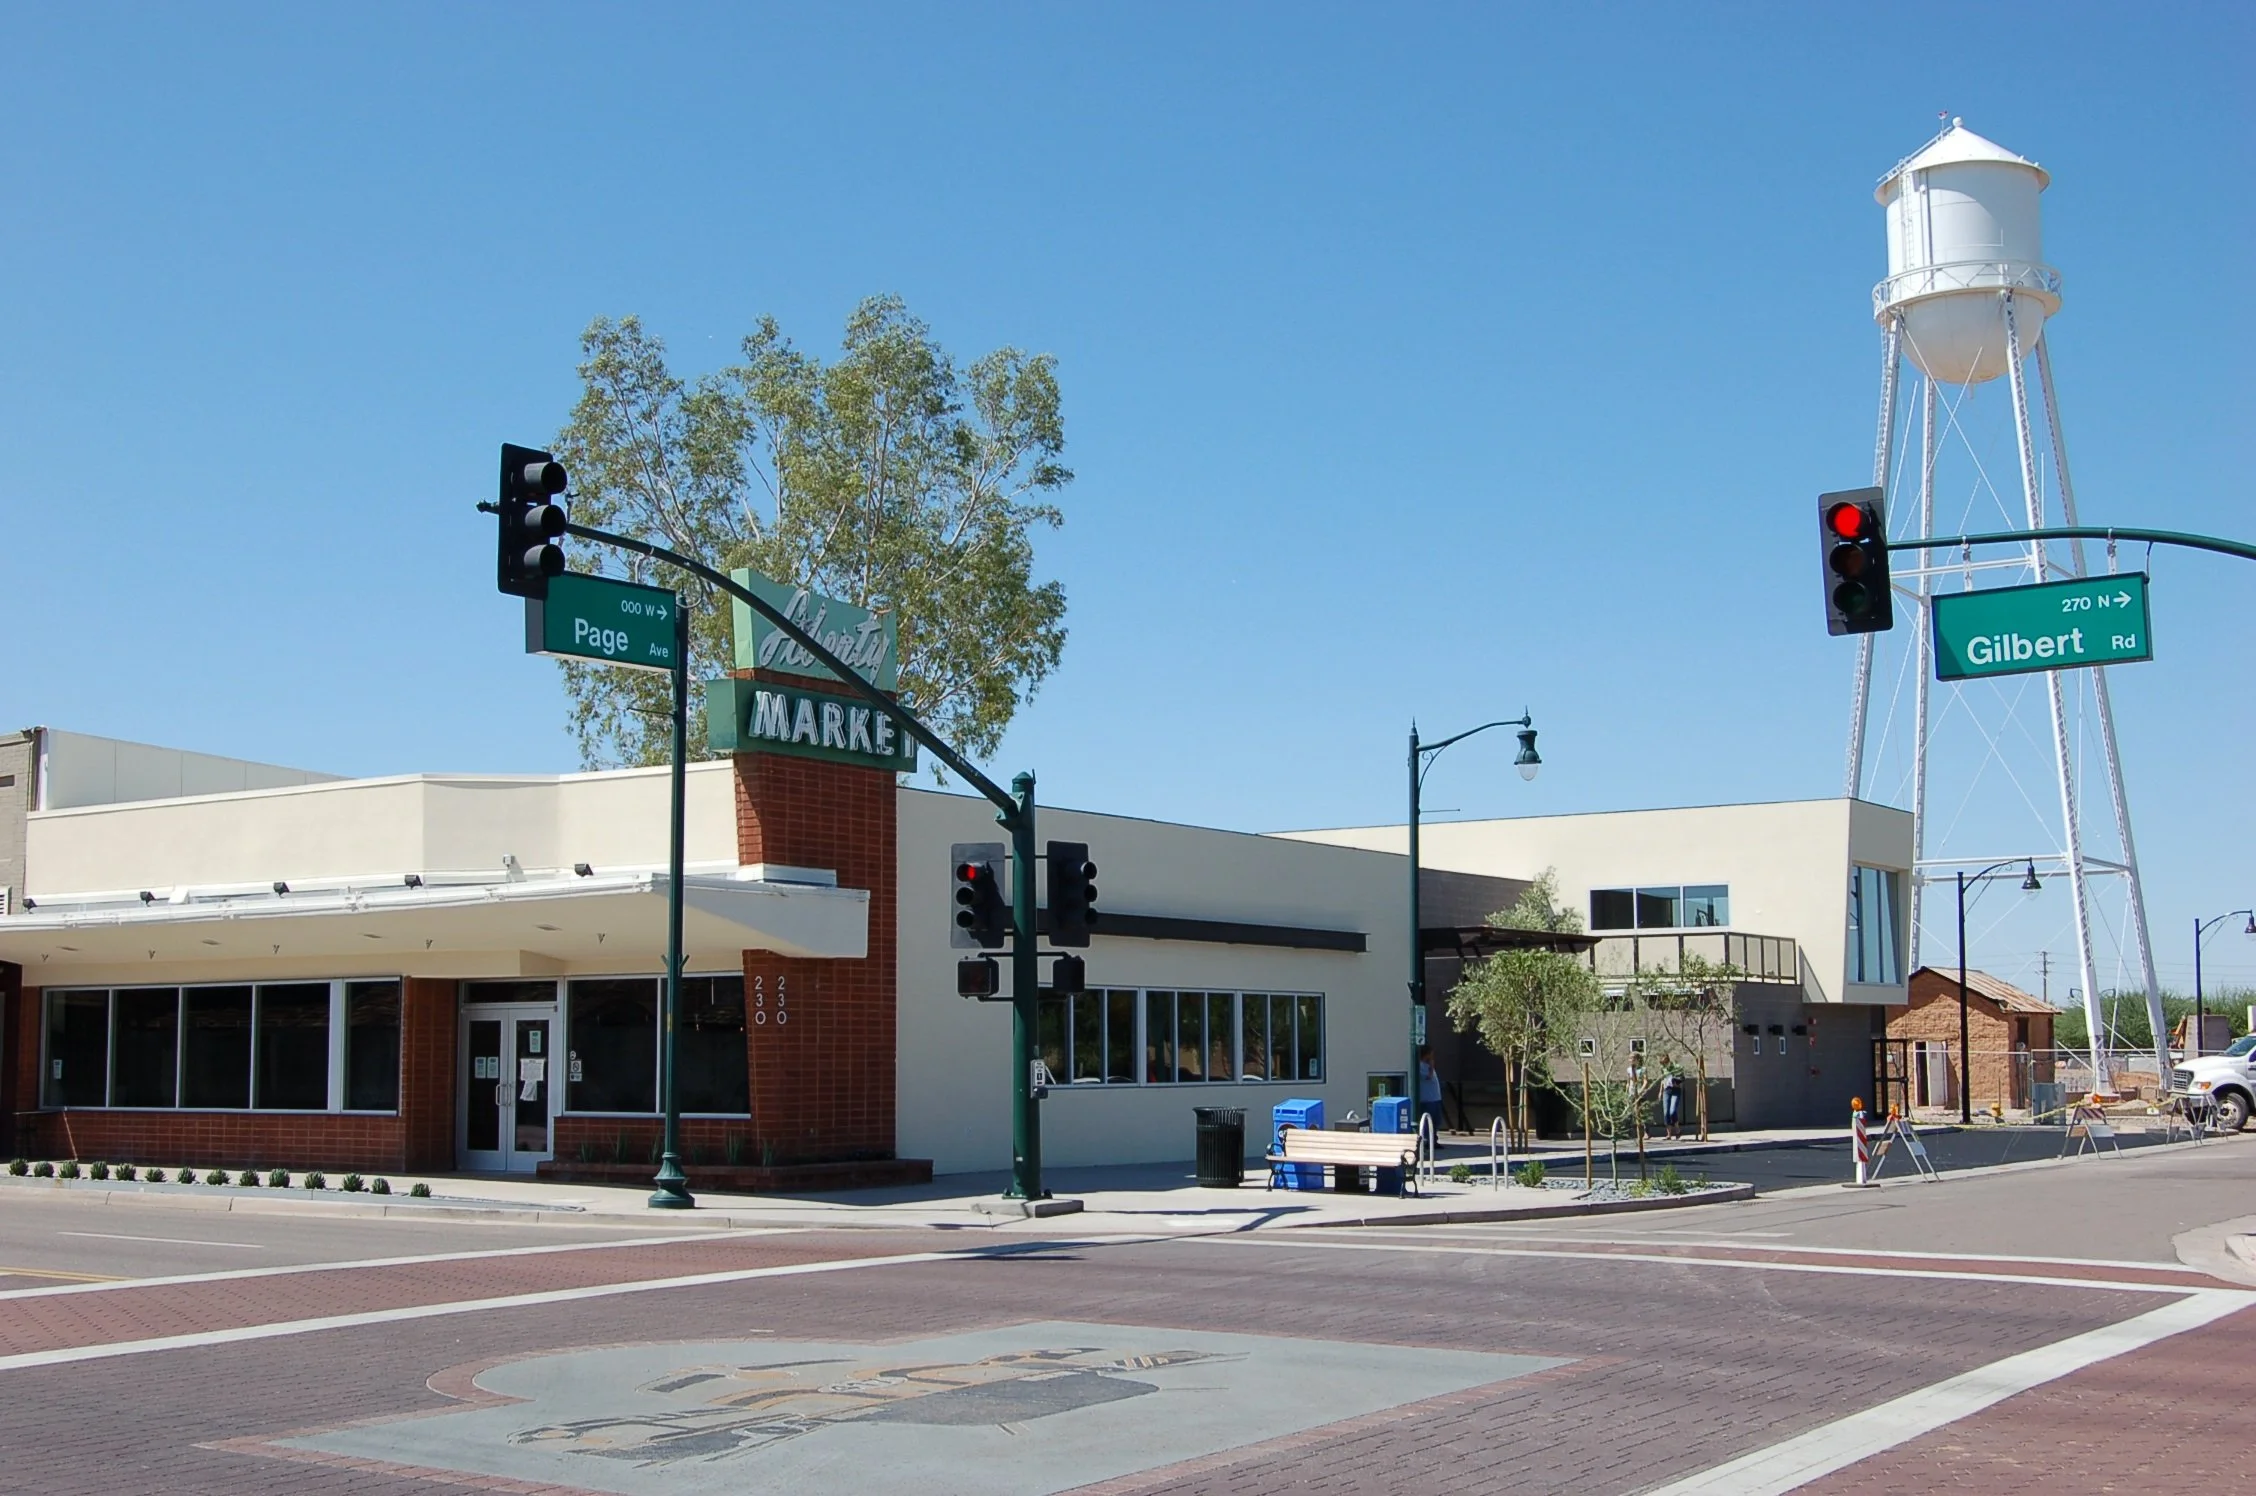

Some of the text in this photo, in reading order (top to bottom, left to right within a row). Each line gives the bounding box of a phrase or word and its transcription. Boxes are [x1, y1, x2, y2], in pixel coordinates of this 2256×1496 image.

[621, 599, 655, 617] 000 W
[2061, 595, 2110, 613] 270 N
[574, 617, 669, 658] Page Ave
[1967, 627, 2136, 665] Gilbert Rd
